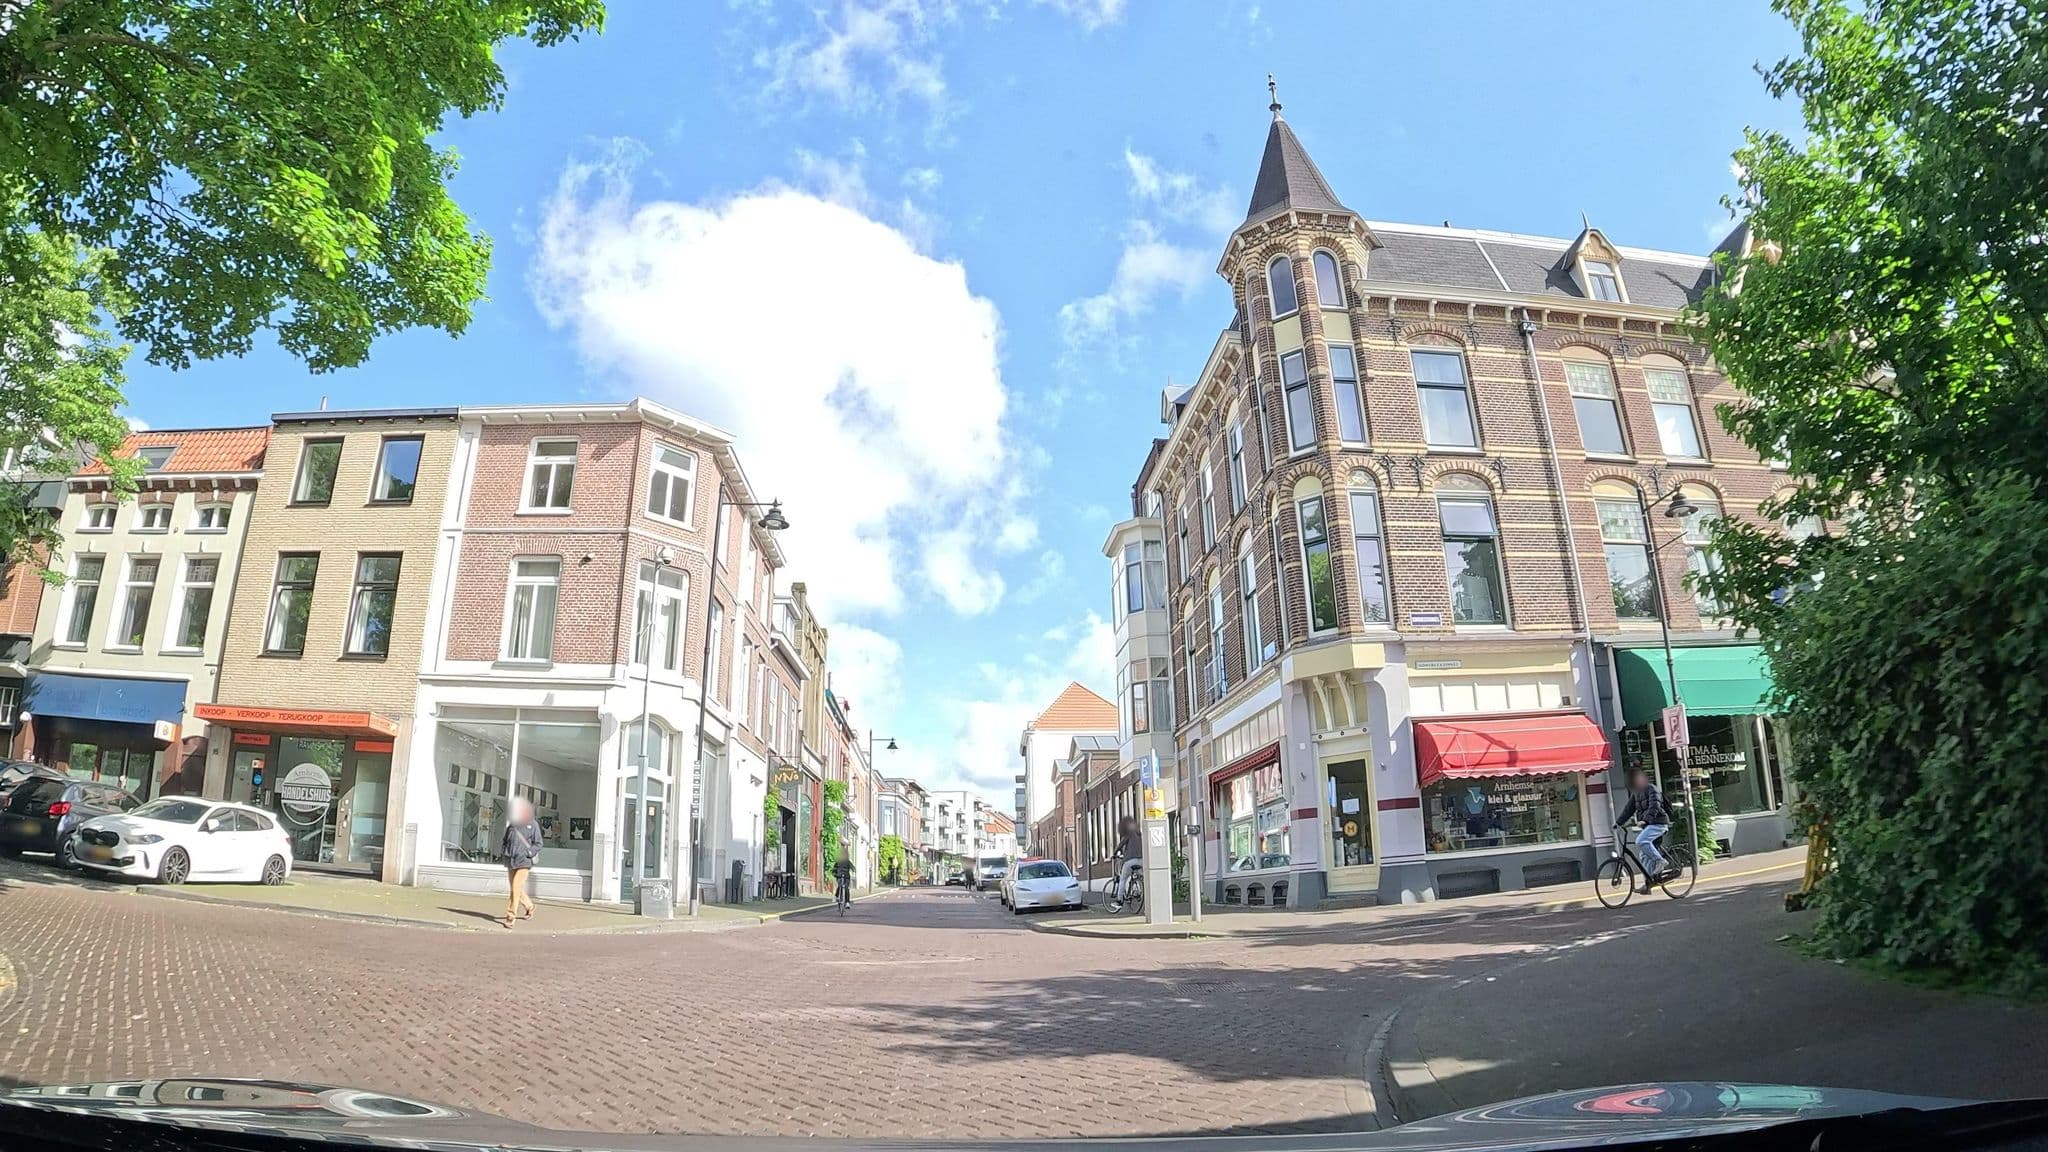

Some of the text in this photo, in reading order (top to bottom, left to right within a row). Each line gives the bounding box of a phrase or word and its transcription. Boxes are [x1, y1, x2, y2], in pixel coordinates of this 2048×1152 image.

[237, 710, 271, 719] VERKOOP
[278, 713, 324, 723] TERUGKOOP
[1677, 752, 1746, 767] vn BENNEKOM
[1494, 781, 1535, 791] Arnhemse
[281, 786, 332, 802] HANDELSHUIS
[1487, 792, 1543, 804] klei & glazuur
[1506, 803, 1528, 813] winkel
